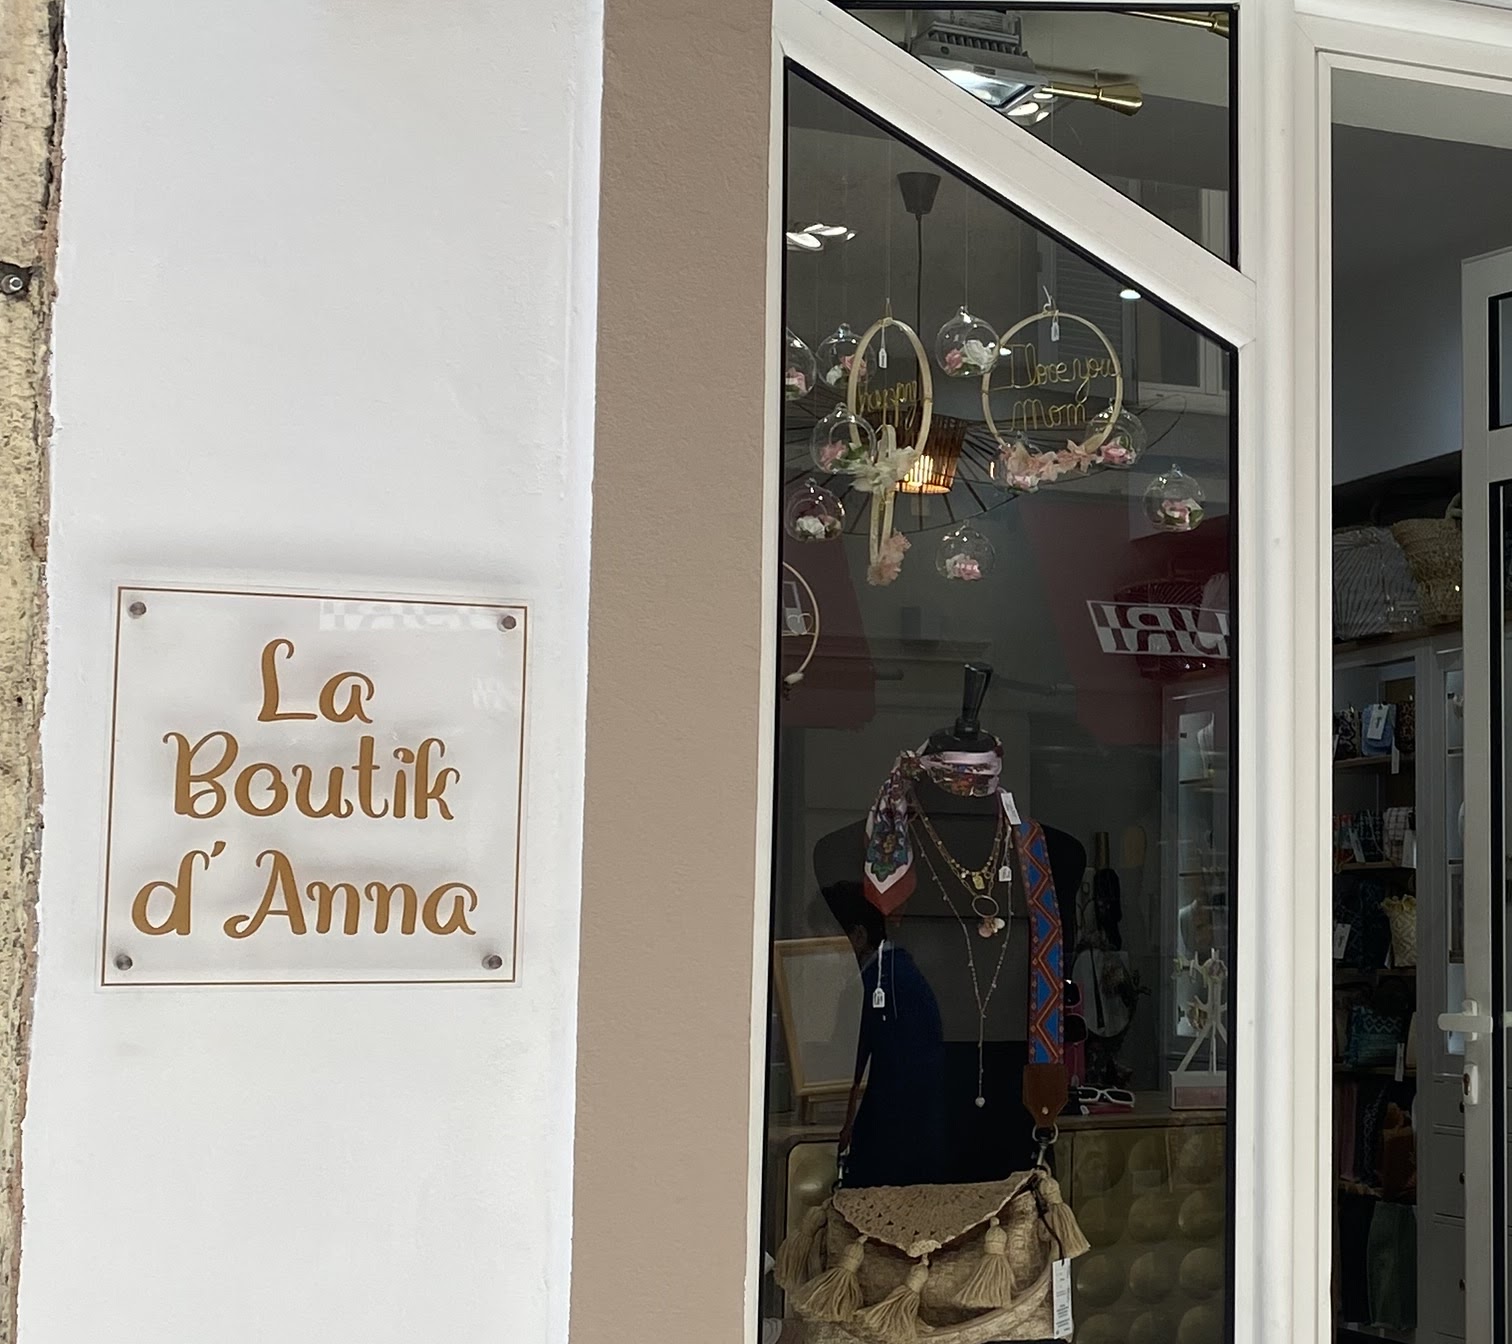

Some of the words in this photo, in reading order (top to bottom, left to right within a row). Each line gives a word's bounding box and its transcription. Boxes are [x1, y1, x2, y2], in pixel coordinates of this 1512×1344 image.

[257, 638, 375, 724] La
[162, 731, 461, 821] Boutik
[131, 840, 478, 939] d'Anna
